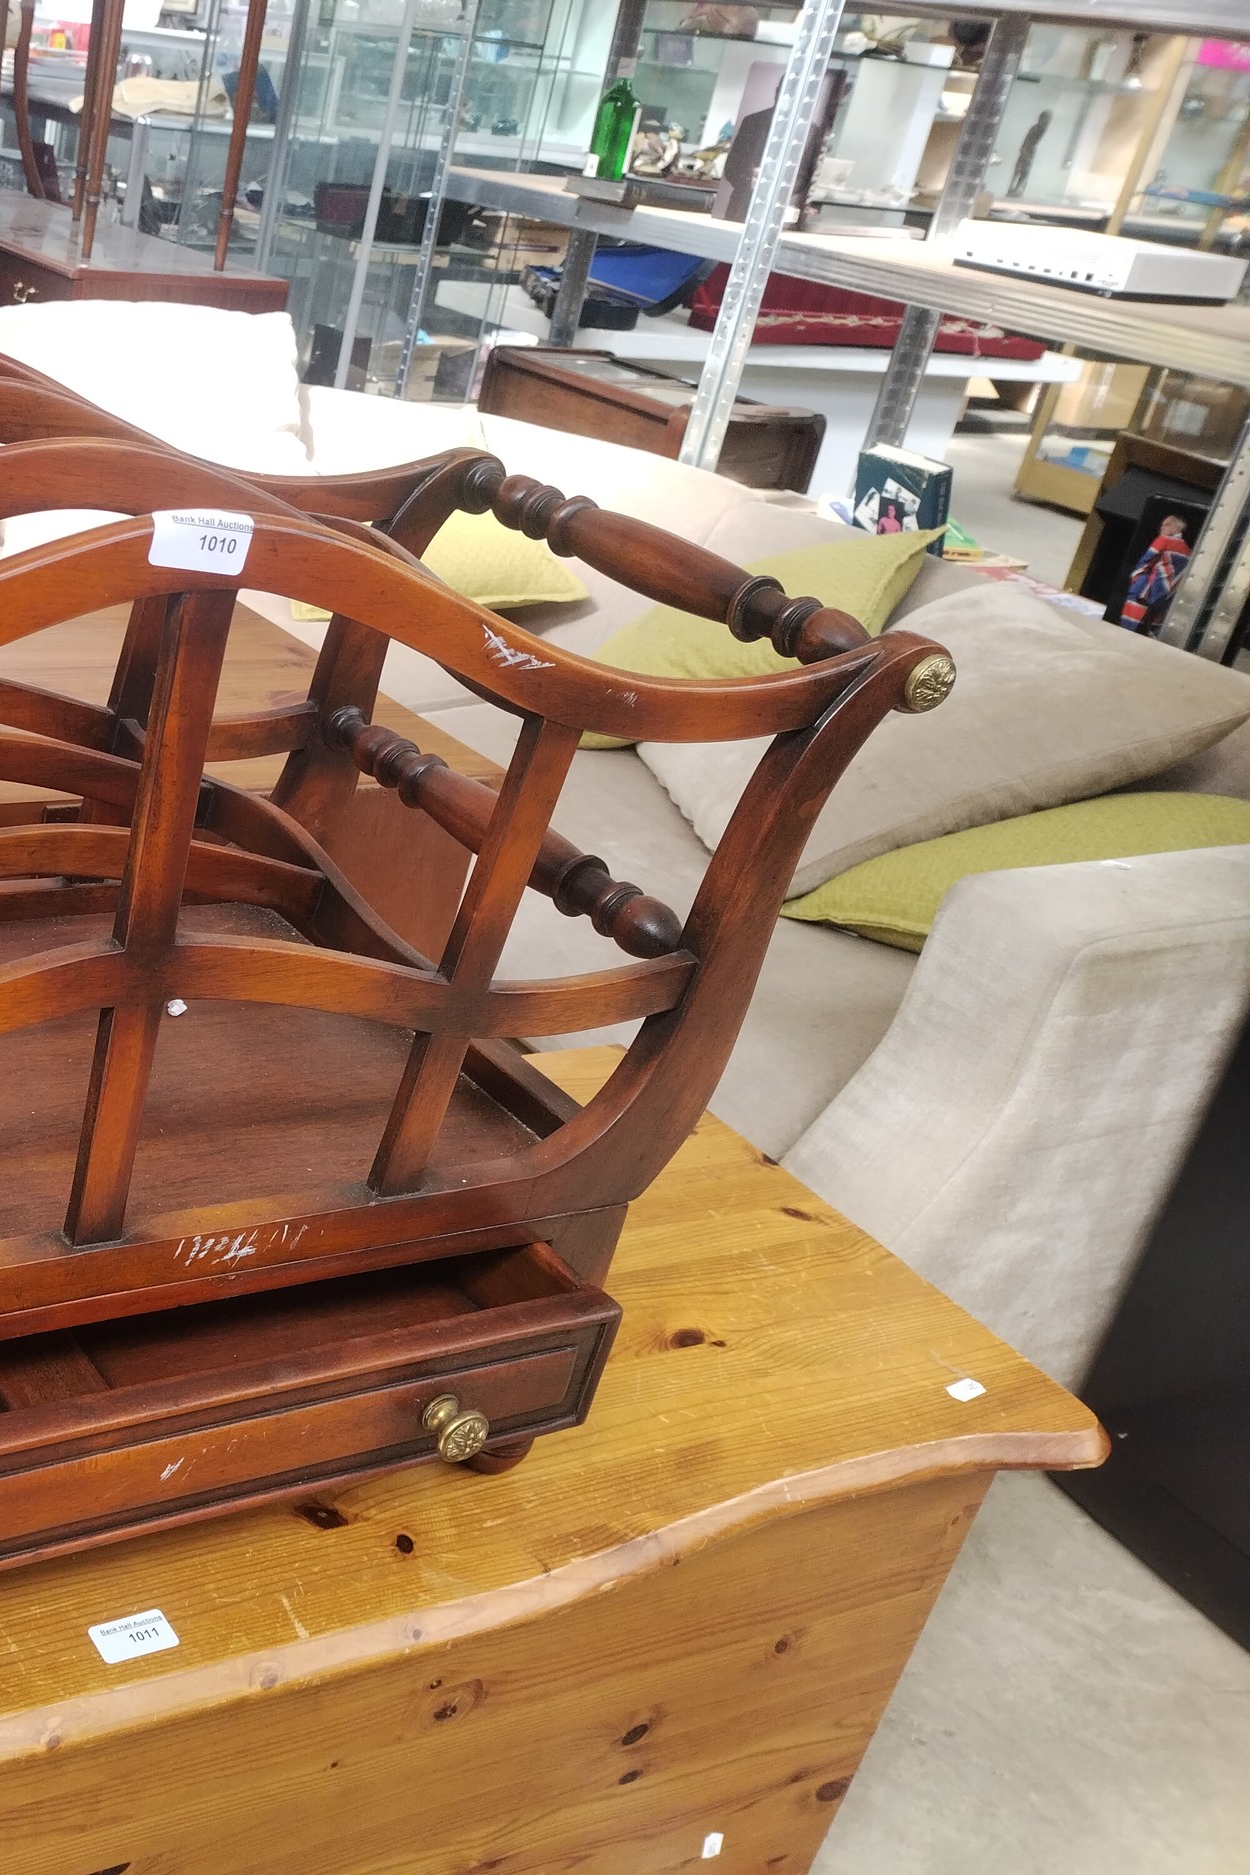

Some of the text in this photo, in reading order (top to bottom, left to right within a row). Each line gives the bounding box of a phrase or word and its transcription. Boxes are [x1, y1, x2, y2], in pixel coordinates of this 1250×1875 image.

[172, 515, 254, 531] Bank Hall Auctions
[199, 534, 238, 554] 1010
[99, 1615, 163, 1637] Bank Hall Auctions
[128, 1627, 160, 1643] 1011
